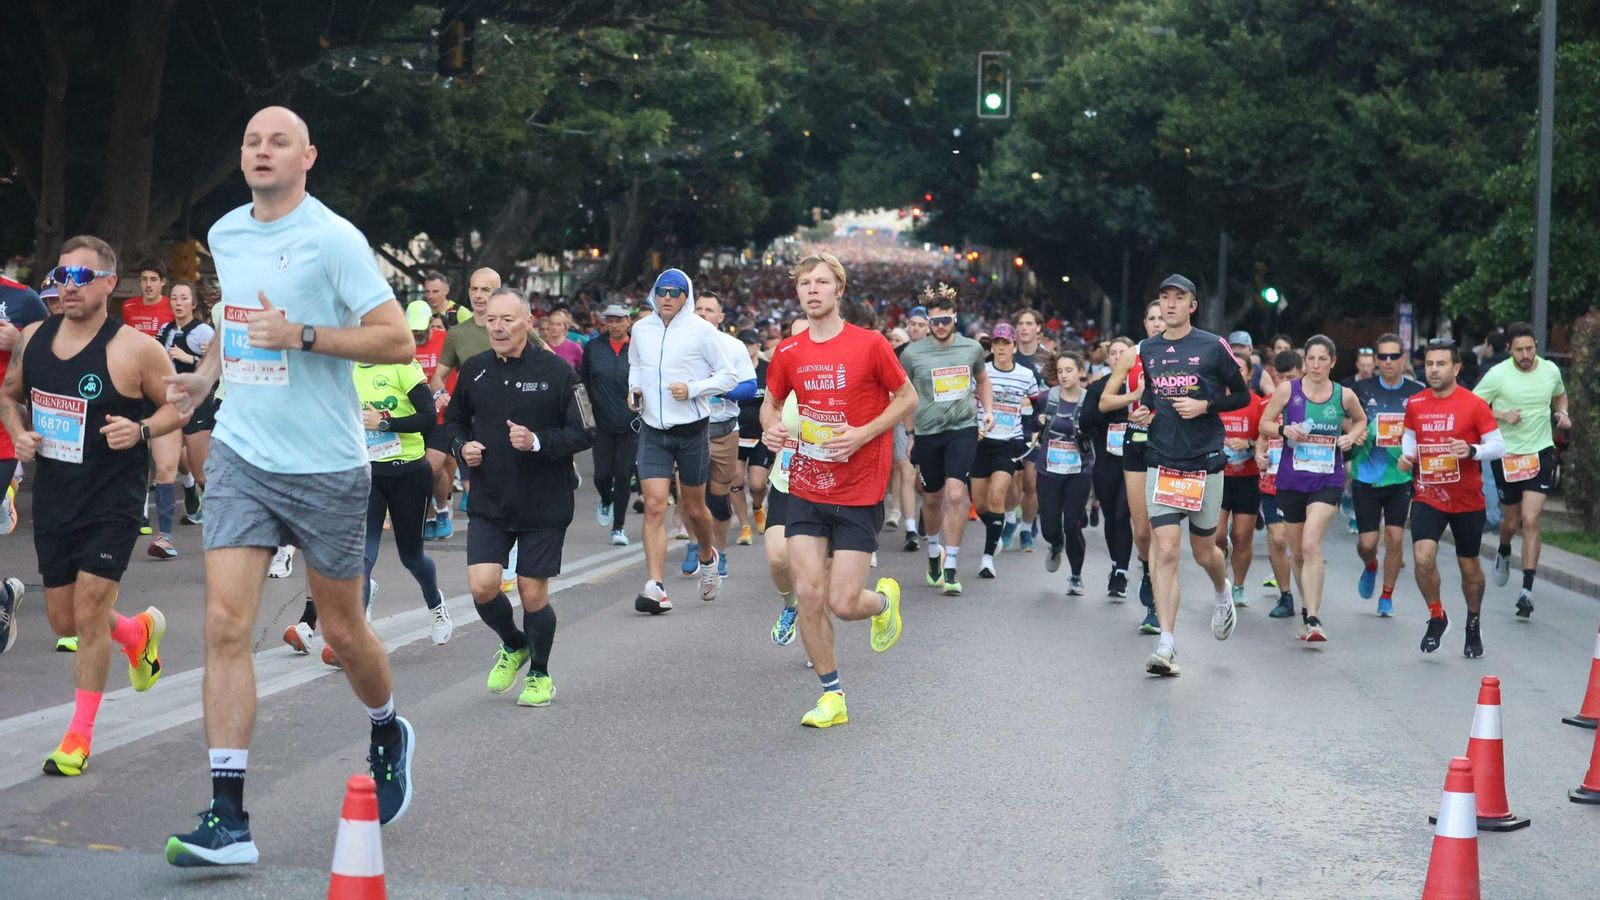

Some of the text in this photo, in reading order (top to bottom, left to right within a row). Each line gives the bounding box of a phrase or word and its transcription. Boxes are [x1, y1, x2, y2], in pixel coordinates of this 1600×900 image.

[804, 379, 835, 391] MÁLAGA
[1152, 375, 1198, 388] MADRID
[40, 395, 80, 412] GENERALI
[808, 409, 843, 423] GENERALI
[37, 414, 70, 432] 16870
[1421, 423, 1446, 432] MÁLAGA
